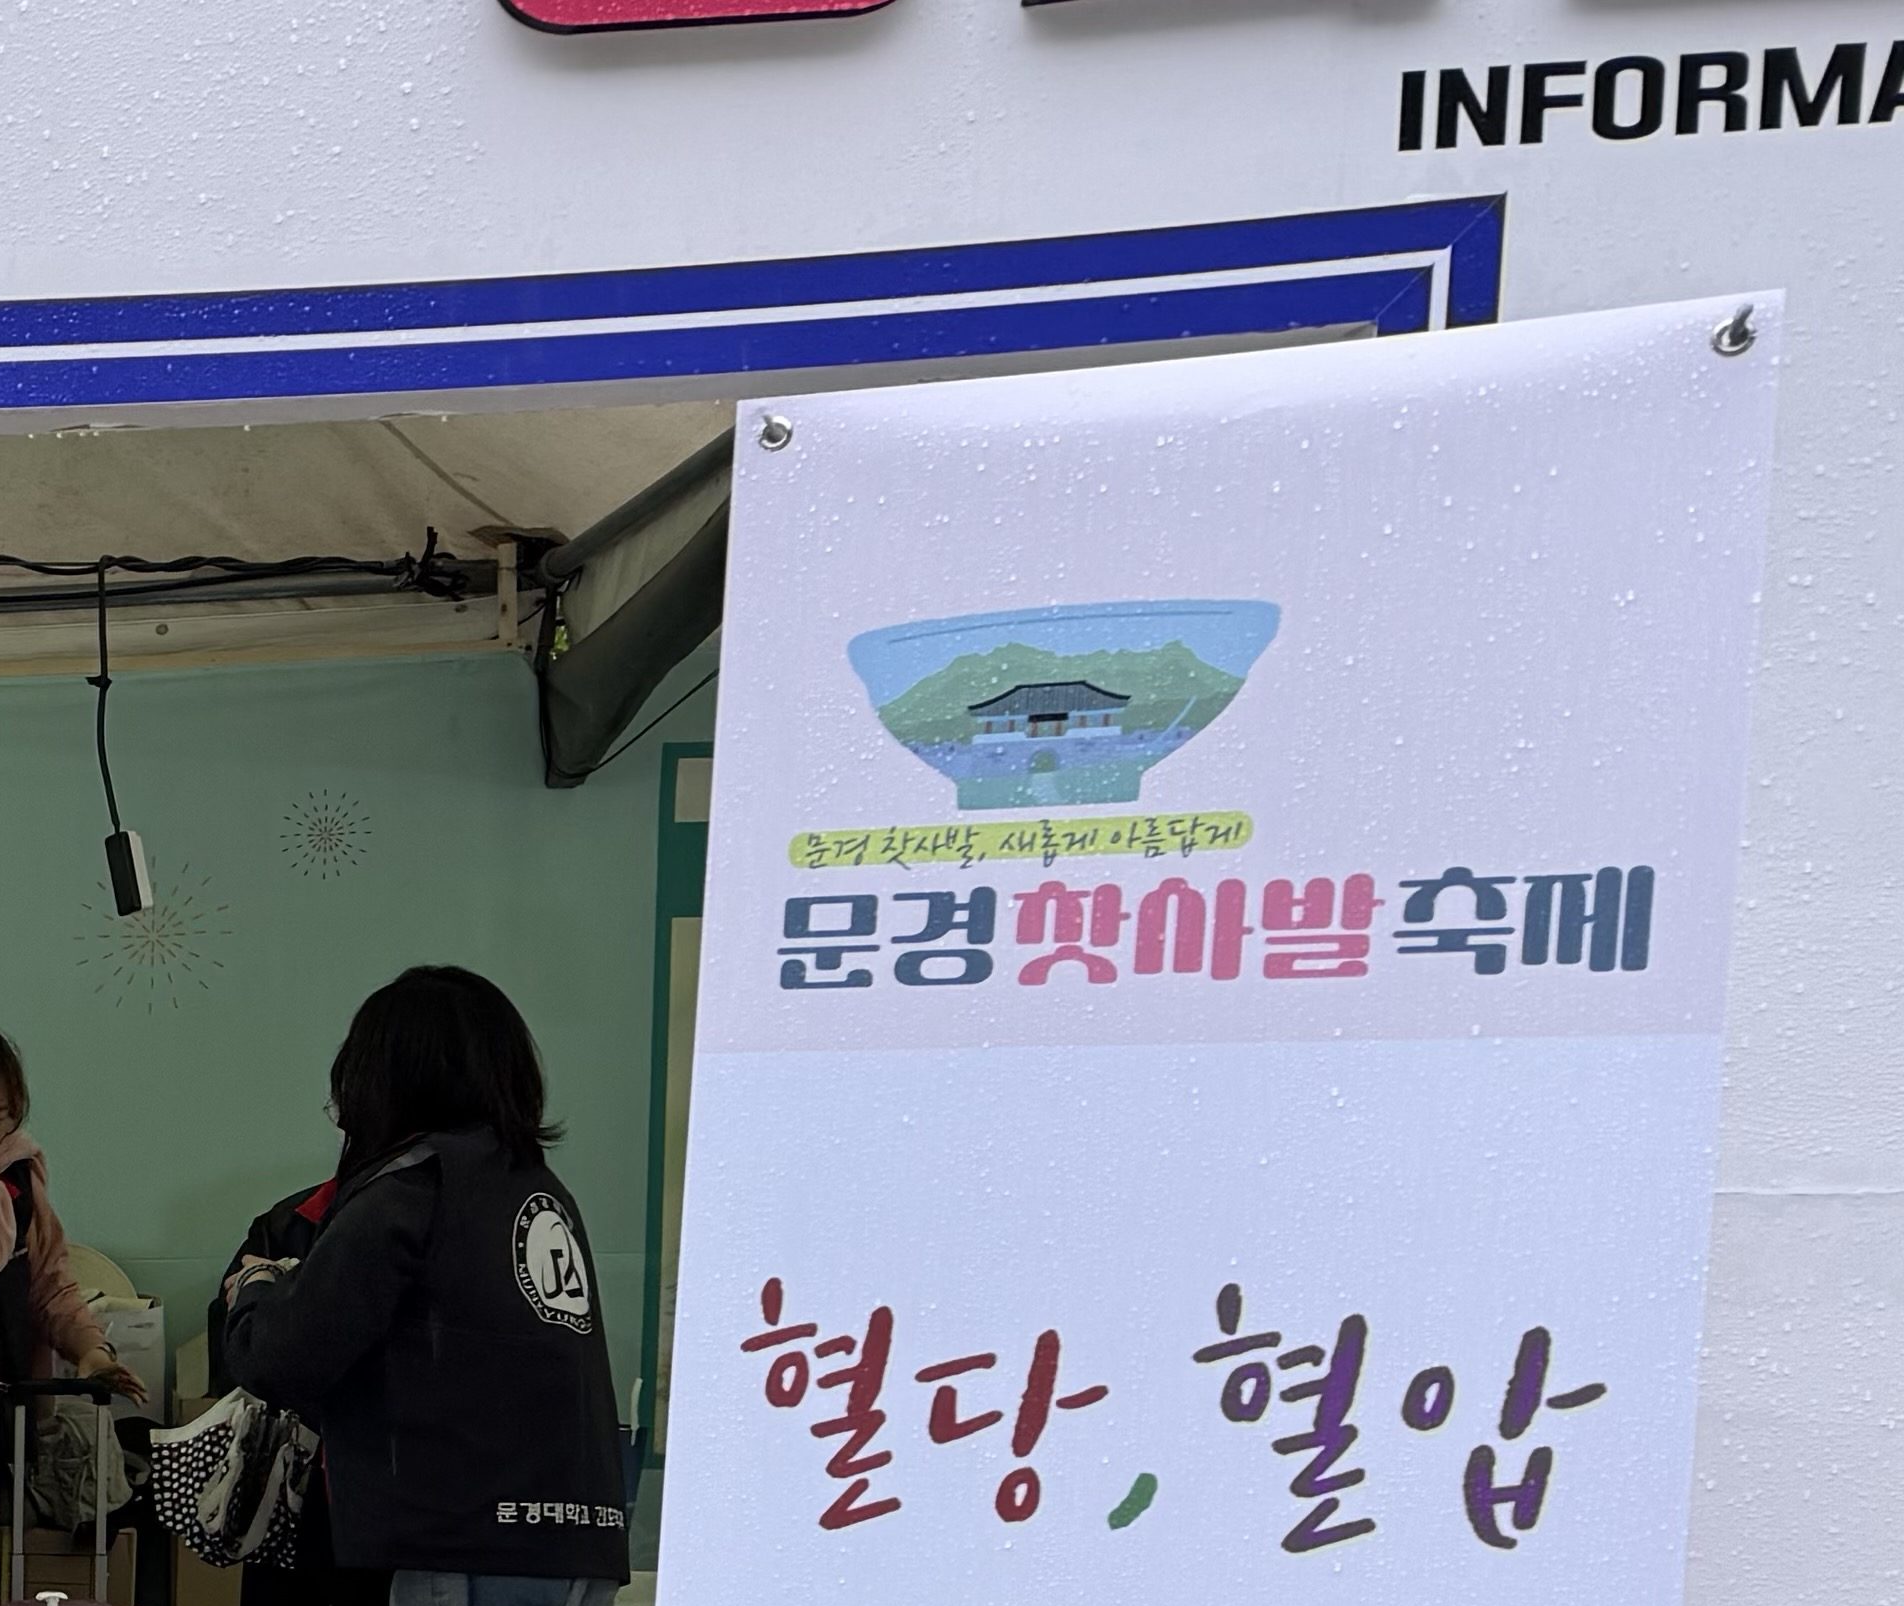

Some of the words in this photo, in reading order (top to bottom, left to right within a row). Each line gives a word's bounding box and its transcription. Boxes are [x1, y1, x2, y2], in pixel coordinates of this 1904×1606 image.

[805, 831, 872, 869] 문경
[880, 825, 987, 871] 찻사발,
[999, 818, 1097, 868] 새롭게
[1109, 816, 1244, 858] 아름답게
[740, 1277, 1159, 1531] 혈당,
[1192, 1283, 1607, 1554] 혈압
